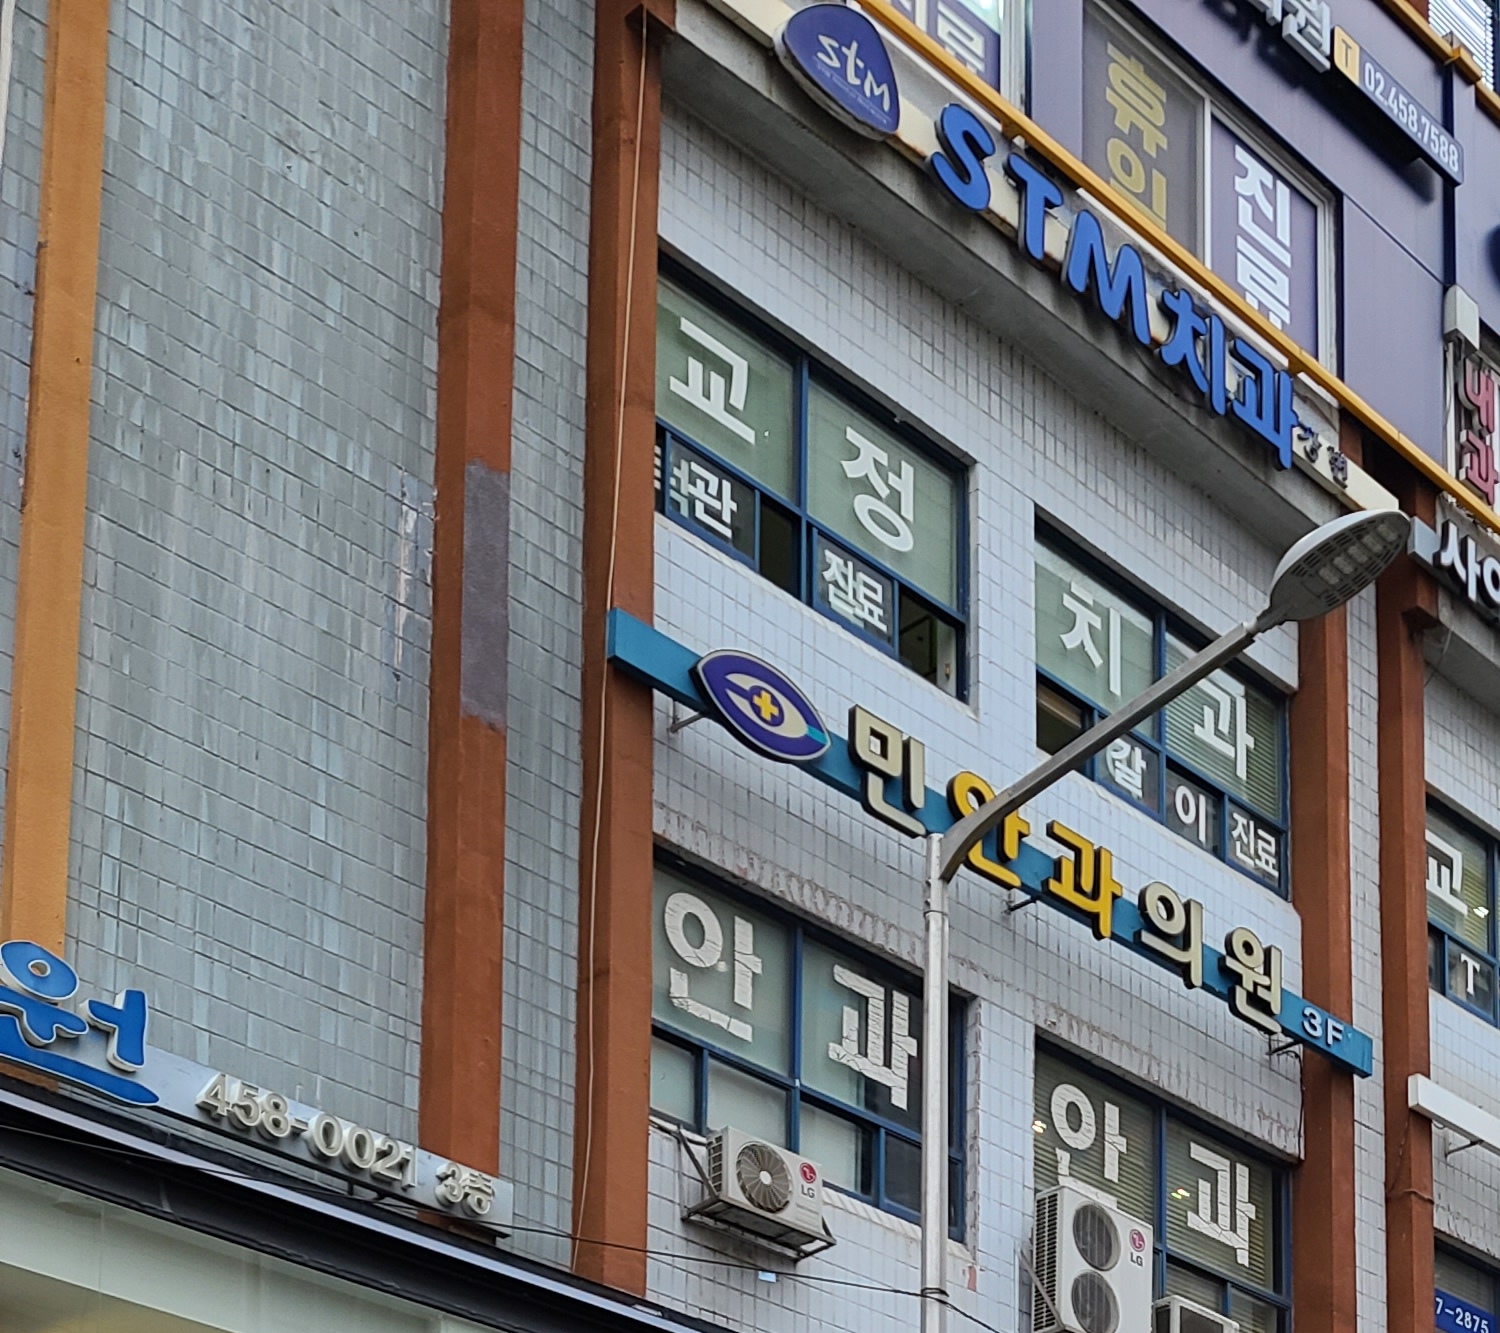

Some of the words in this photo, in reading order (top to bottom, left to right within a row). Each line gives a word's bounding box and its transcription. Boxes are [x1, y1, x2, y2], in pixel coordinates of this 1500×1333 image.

[816, 34, 891, 113] stm
[1364, 62, 1459, 174] 02.458.7588
[928, 103, 1298, 470] STM치과
[1234, 144, 1292, 332] 진료
[849, 704, 1284, 1036] 민안과의원
[1303, 1005, 1346, 1049] 3F
[1231, 811, 1280, 880] 진료
[195, 1072, 418, 1191] 458-0021
[433, 1162, 496, 1218] 3층
[801, 1182, 815, 1199] LG
[1129, 1251, 1144, 1267] LG
